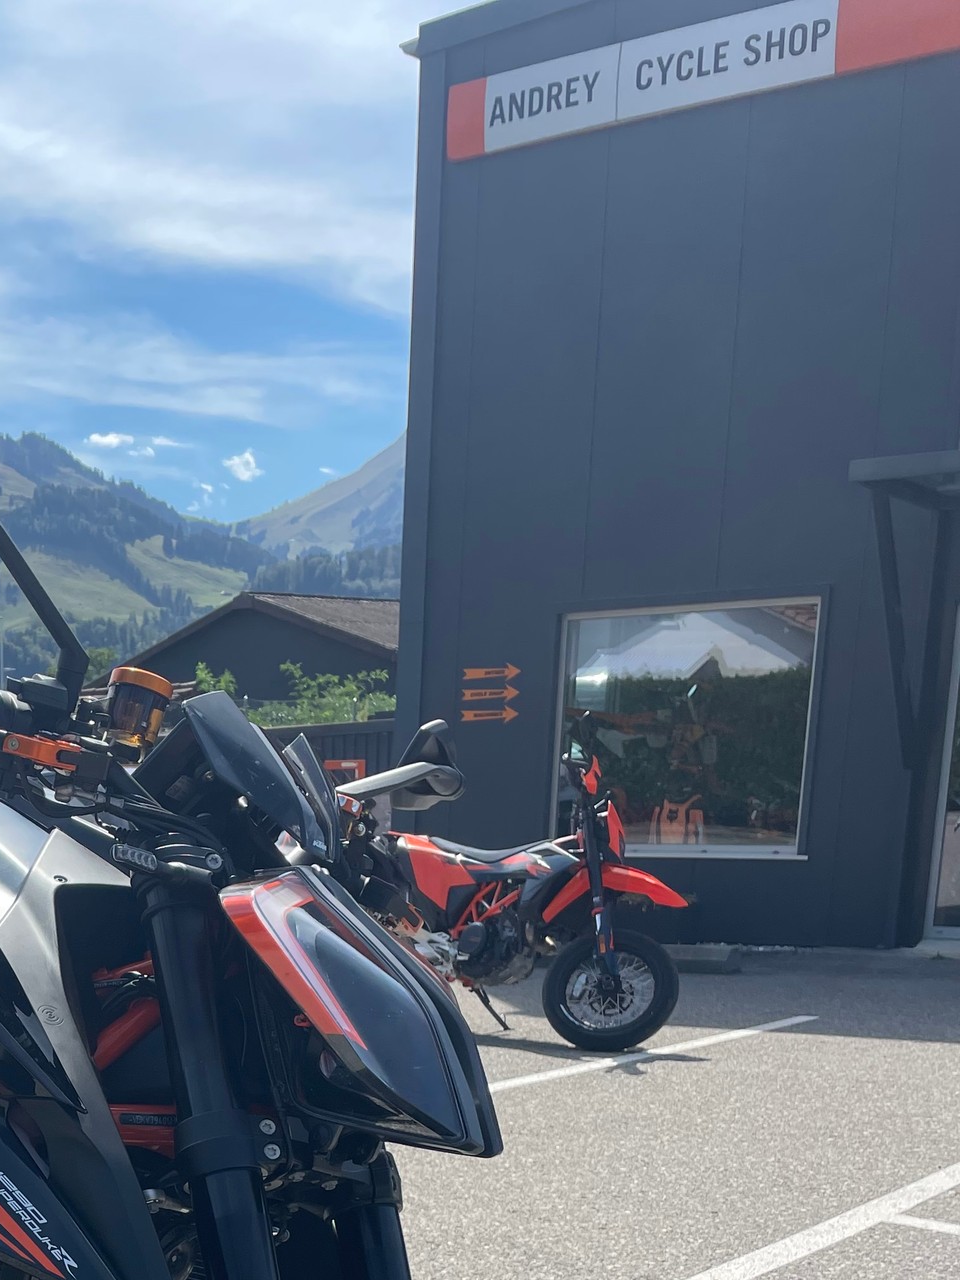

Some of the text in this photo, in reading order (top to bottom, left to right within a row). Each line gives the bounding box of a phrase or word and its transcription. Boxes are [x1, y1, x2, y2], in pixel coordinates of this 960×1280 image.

[489, 18, 832, 127] ANDREY CYCLE SHOP
